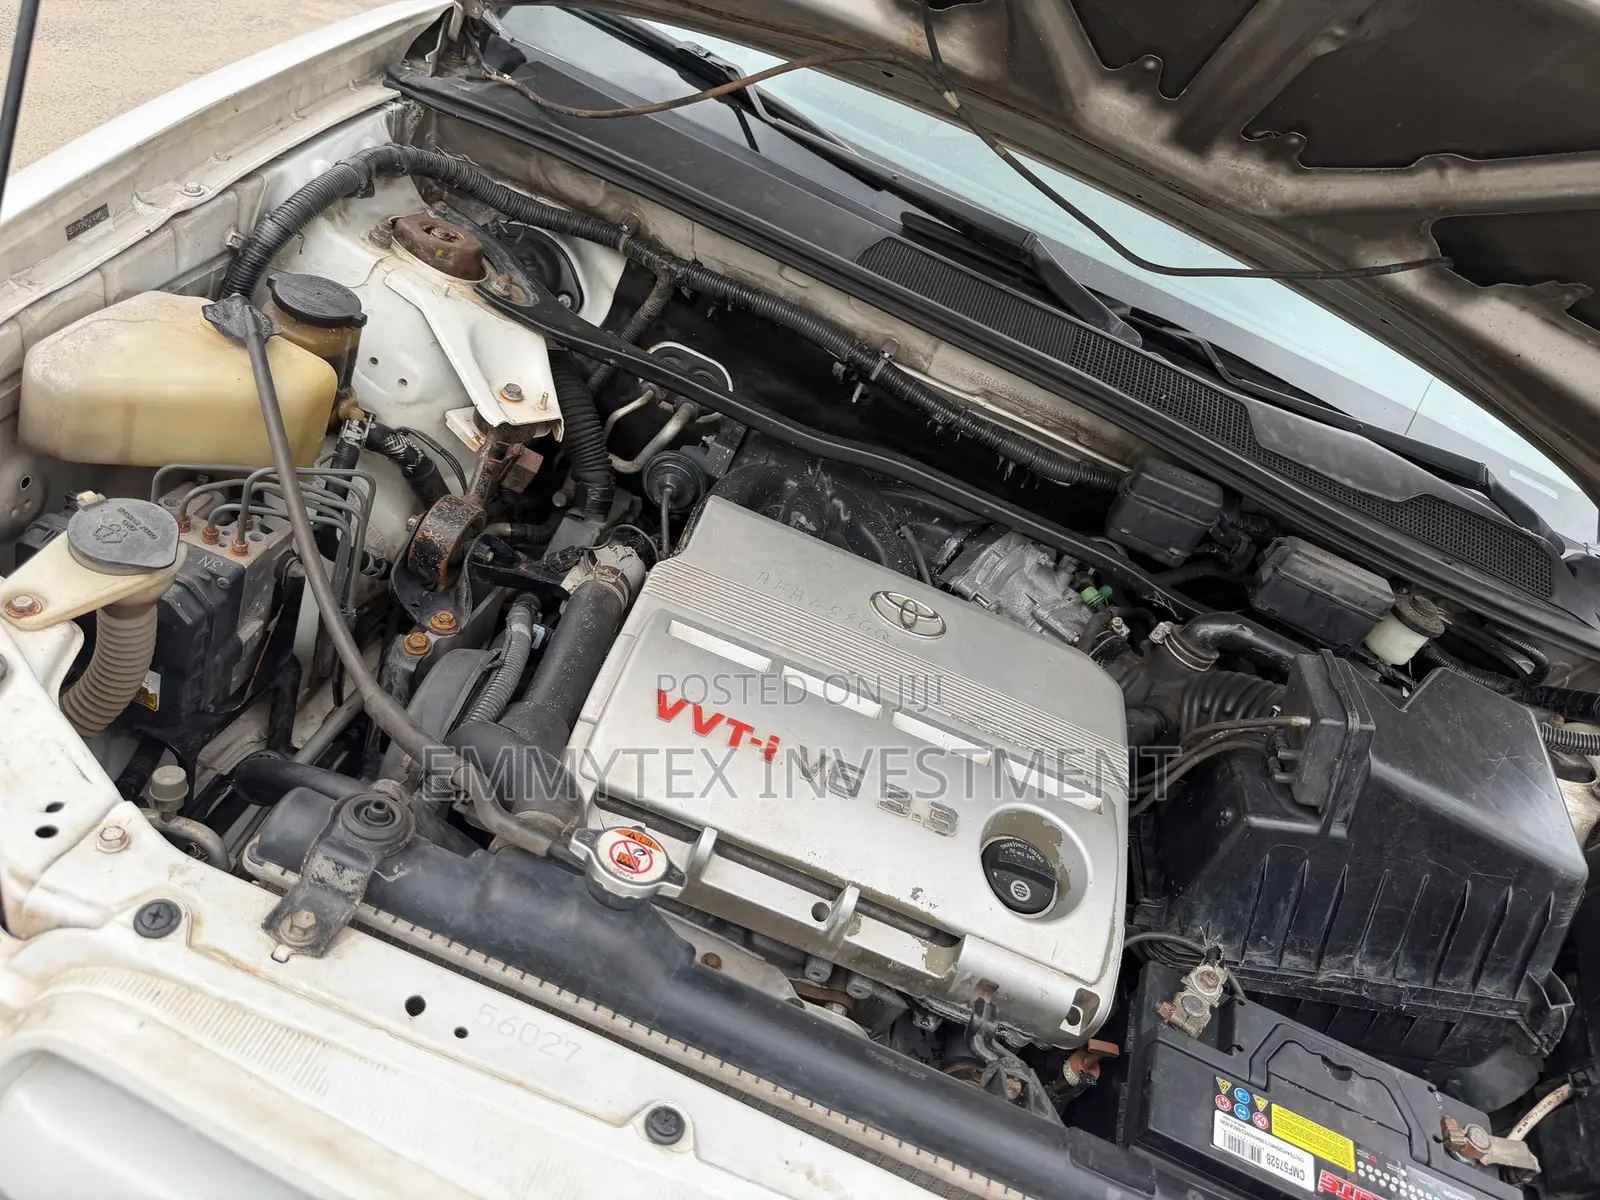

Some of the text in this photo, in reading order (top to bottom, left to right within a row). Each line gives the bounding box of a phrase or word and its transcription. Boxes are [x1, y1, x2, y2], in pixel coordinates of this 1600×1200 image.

[656, 688, 781, 764] VVT-i
[798, 744, 867, 800] V6
[476, 1003, 582, 1064] 56027
[1265, 1153, 1305, 1181] CMF57528
